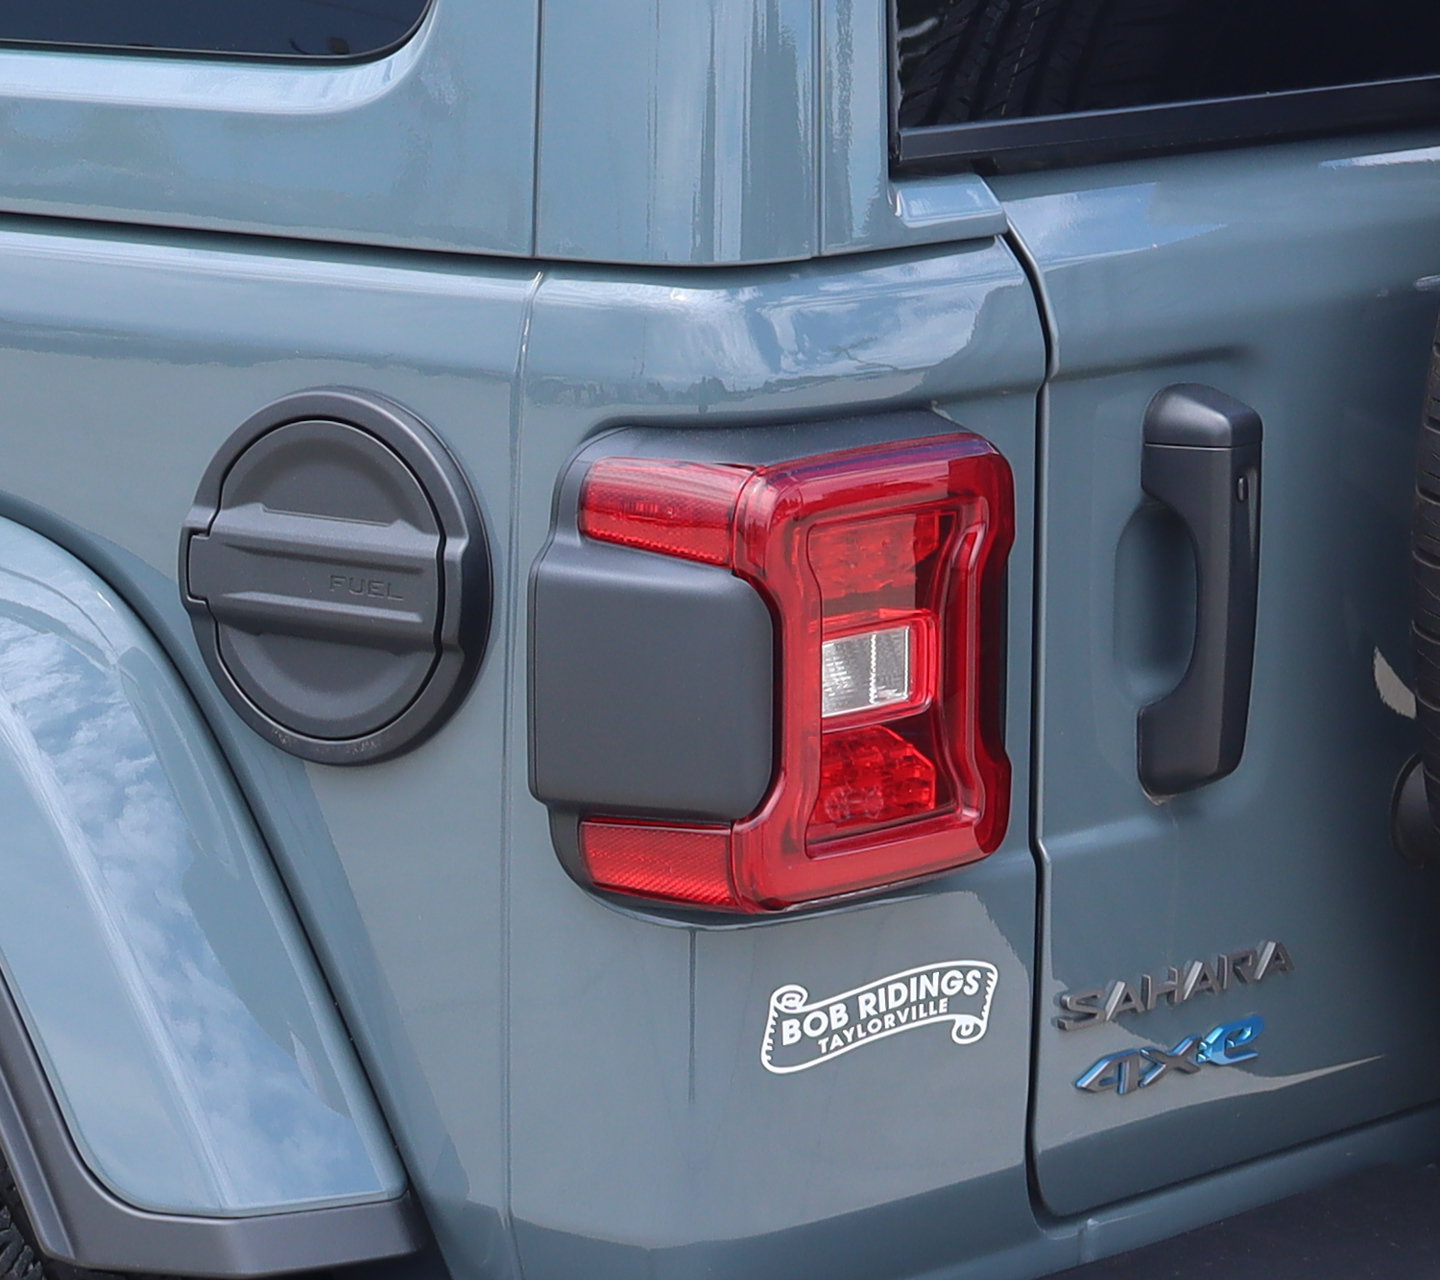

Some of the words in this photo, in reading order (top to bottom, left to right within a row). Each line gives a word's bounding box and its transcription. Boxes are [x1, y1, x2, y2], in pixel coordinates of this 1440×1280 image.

[329, 573, 404, 602] FUEL
[780, 1002, 850, 1046] BOB
[857, 968, 981, 1018] RIDINGS
[1052, 939, 1296, 1032] SAHARA
[817, 997, 949, 1055] TAYLORVILLE
